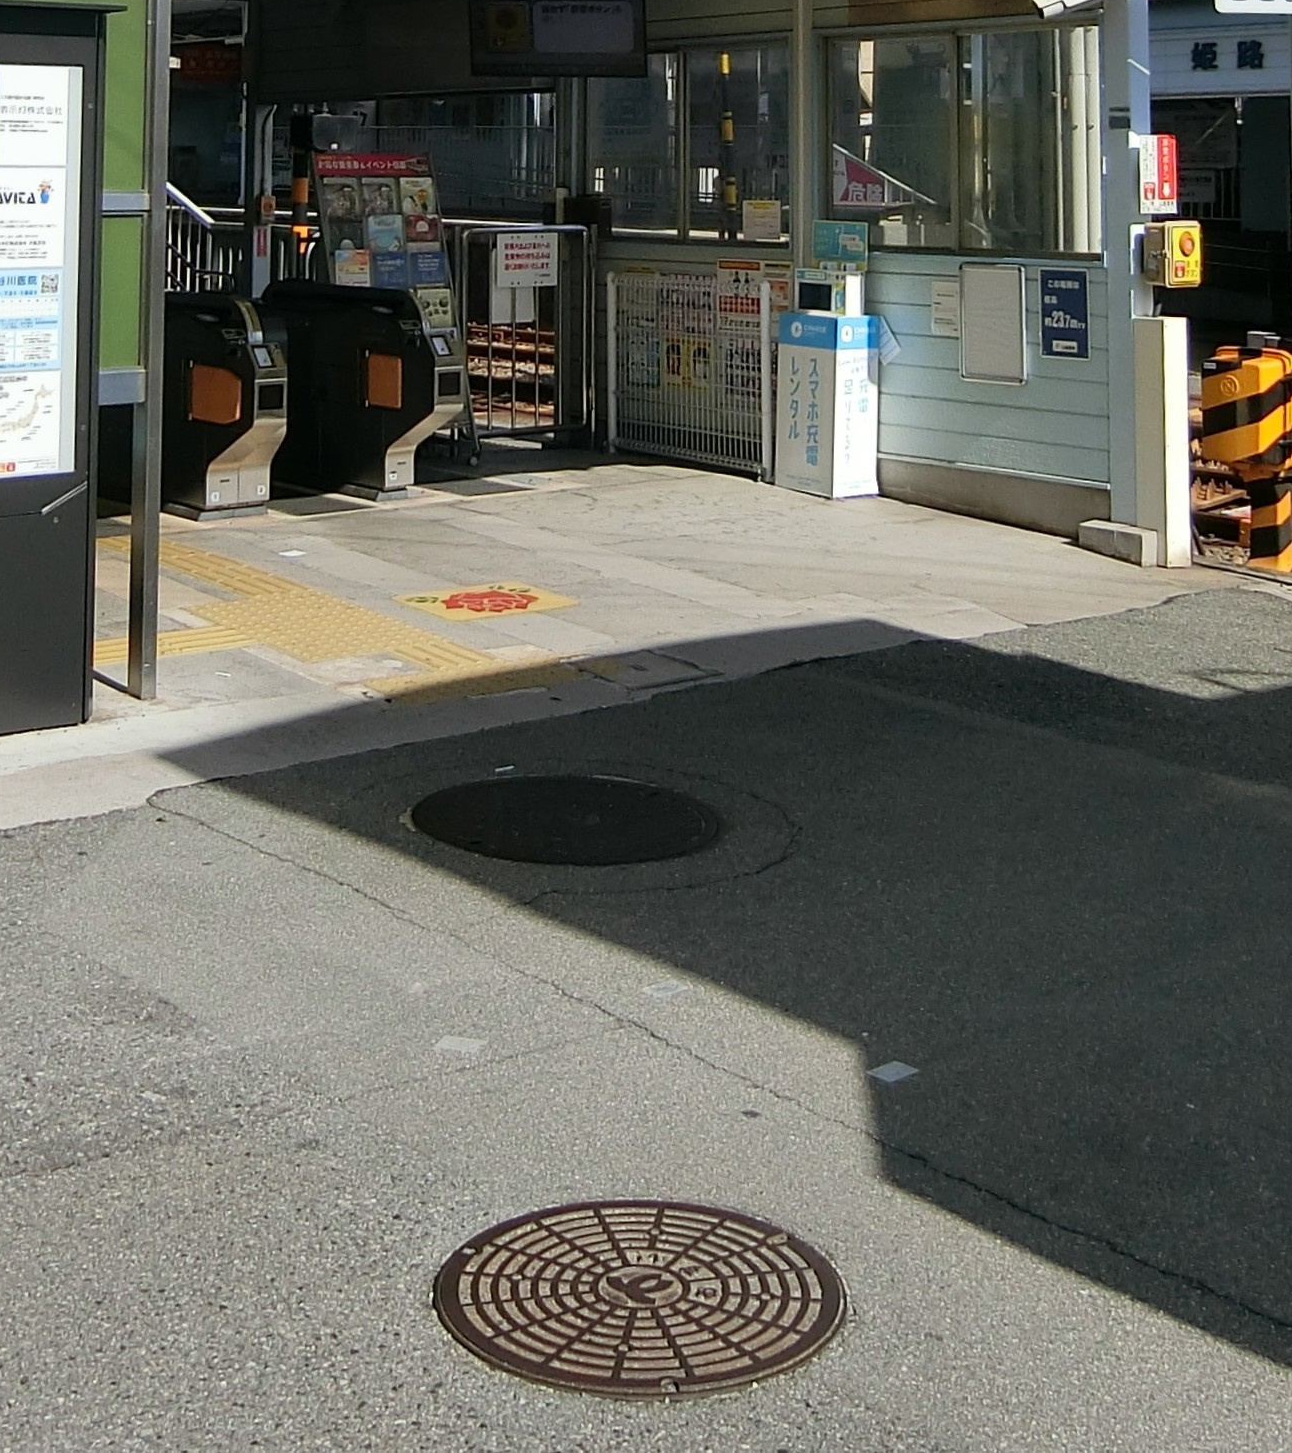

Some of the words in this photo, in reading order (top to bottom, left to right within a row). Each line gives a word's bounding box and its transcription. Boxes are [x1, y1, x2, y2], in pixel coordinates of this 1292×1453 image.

[848, 181, 883, 203] 危険
[787, 356, 800, 440] レンタル
[805, 357, 820, 467] スマホ充電
